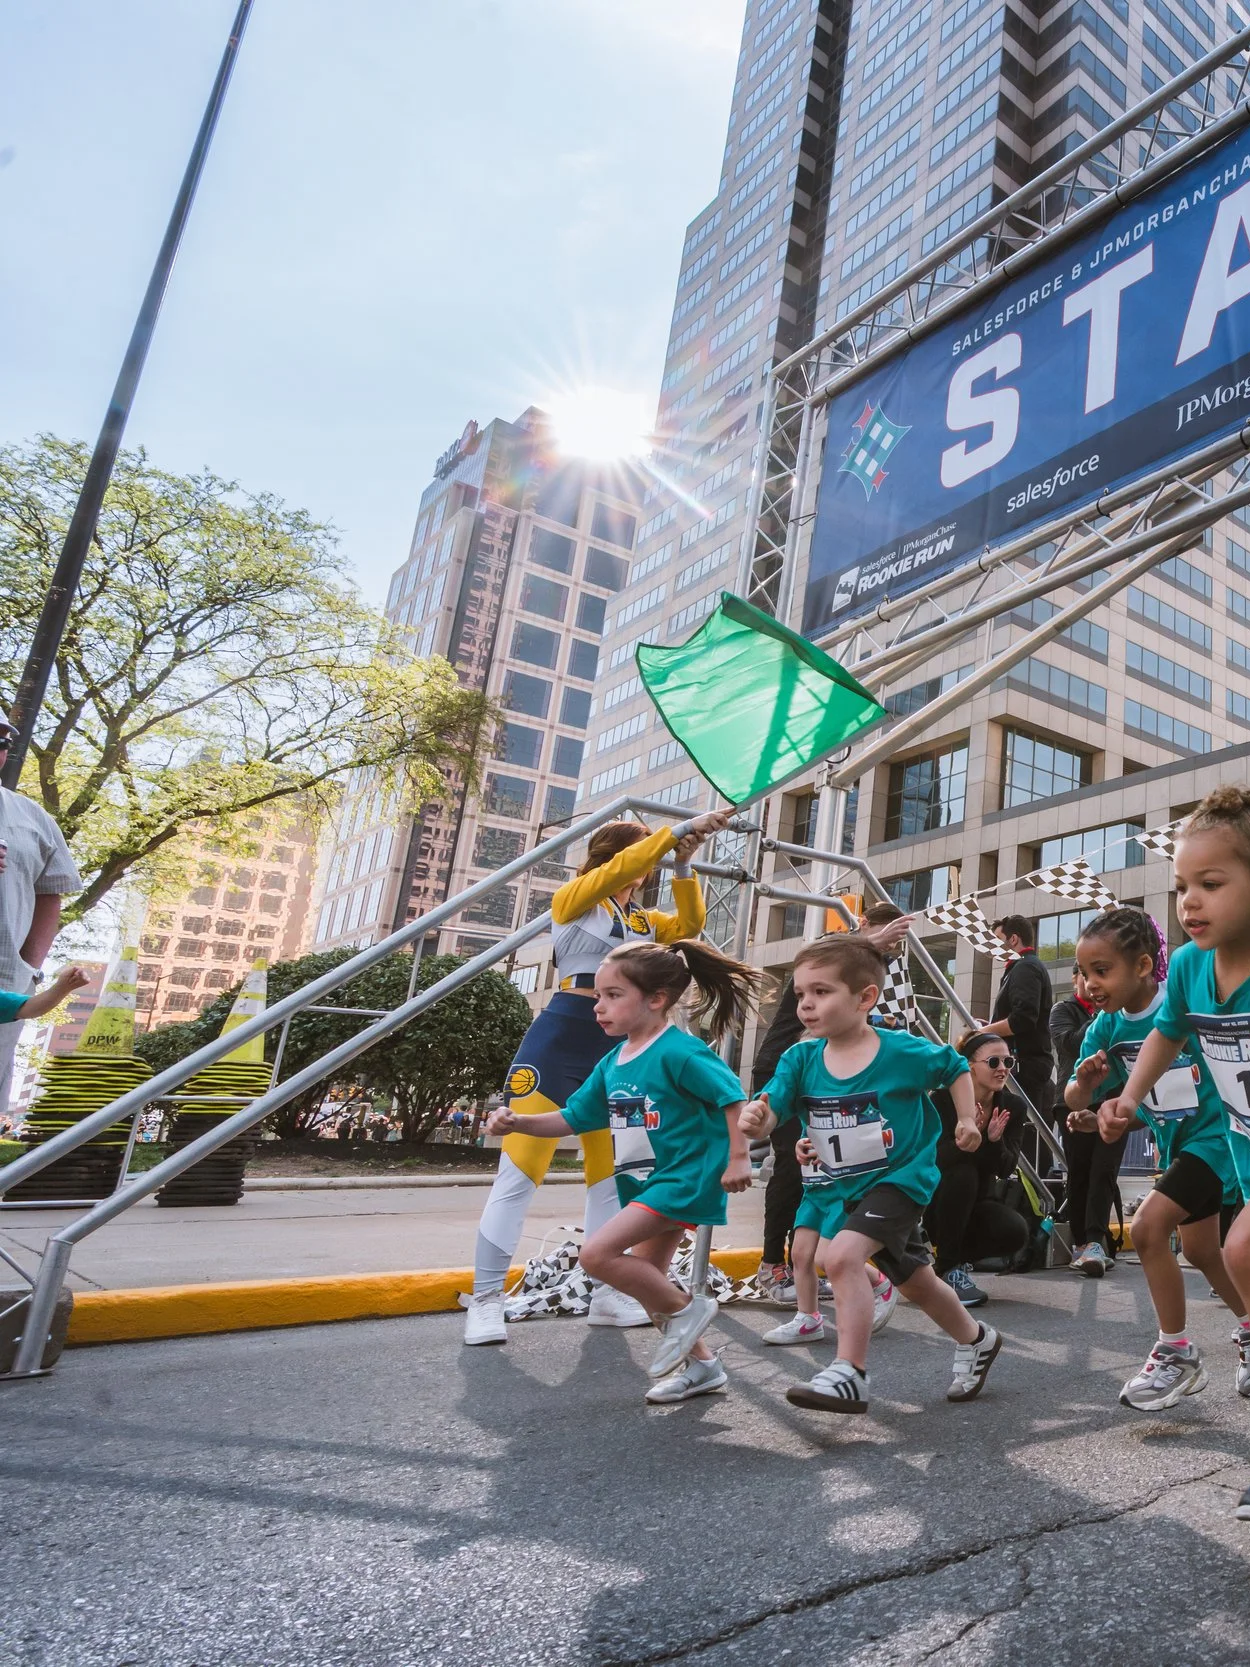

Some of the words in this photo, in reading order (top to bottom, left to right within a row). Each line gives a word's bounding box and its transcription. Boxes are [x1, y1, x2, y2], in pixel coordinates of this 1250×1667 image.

[952, 274, 1064, 357] SALESFORCE
[1071, 262, 1082, 281] &
[1006, 454, 1100, 514] salesforce
[857, 555, 913, 596] ROOKIE
[913, 535, 955, 568] RUN
[861, 551, 897, 574] salesforce
[902, 522, 957, 555] JPMorganChase
[87, 1035, 120, 1045] DPW
[832, 1112, 857, 1129] RUN
[828, 1134, 843, 1163] 1
